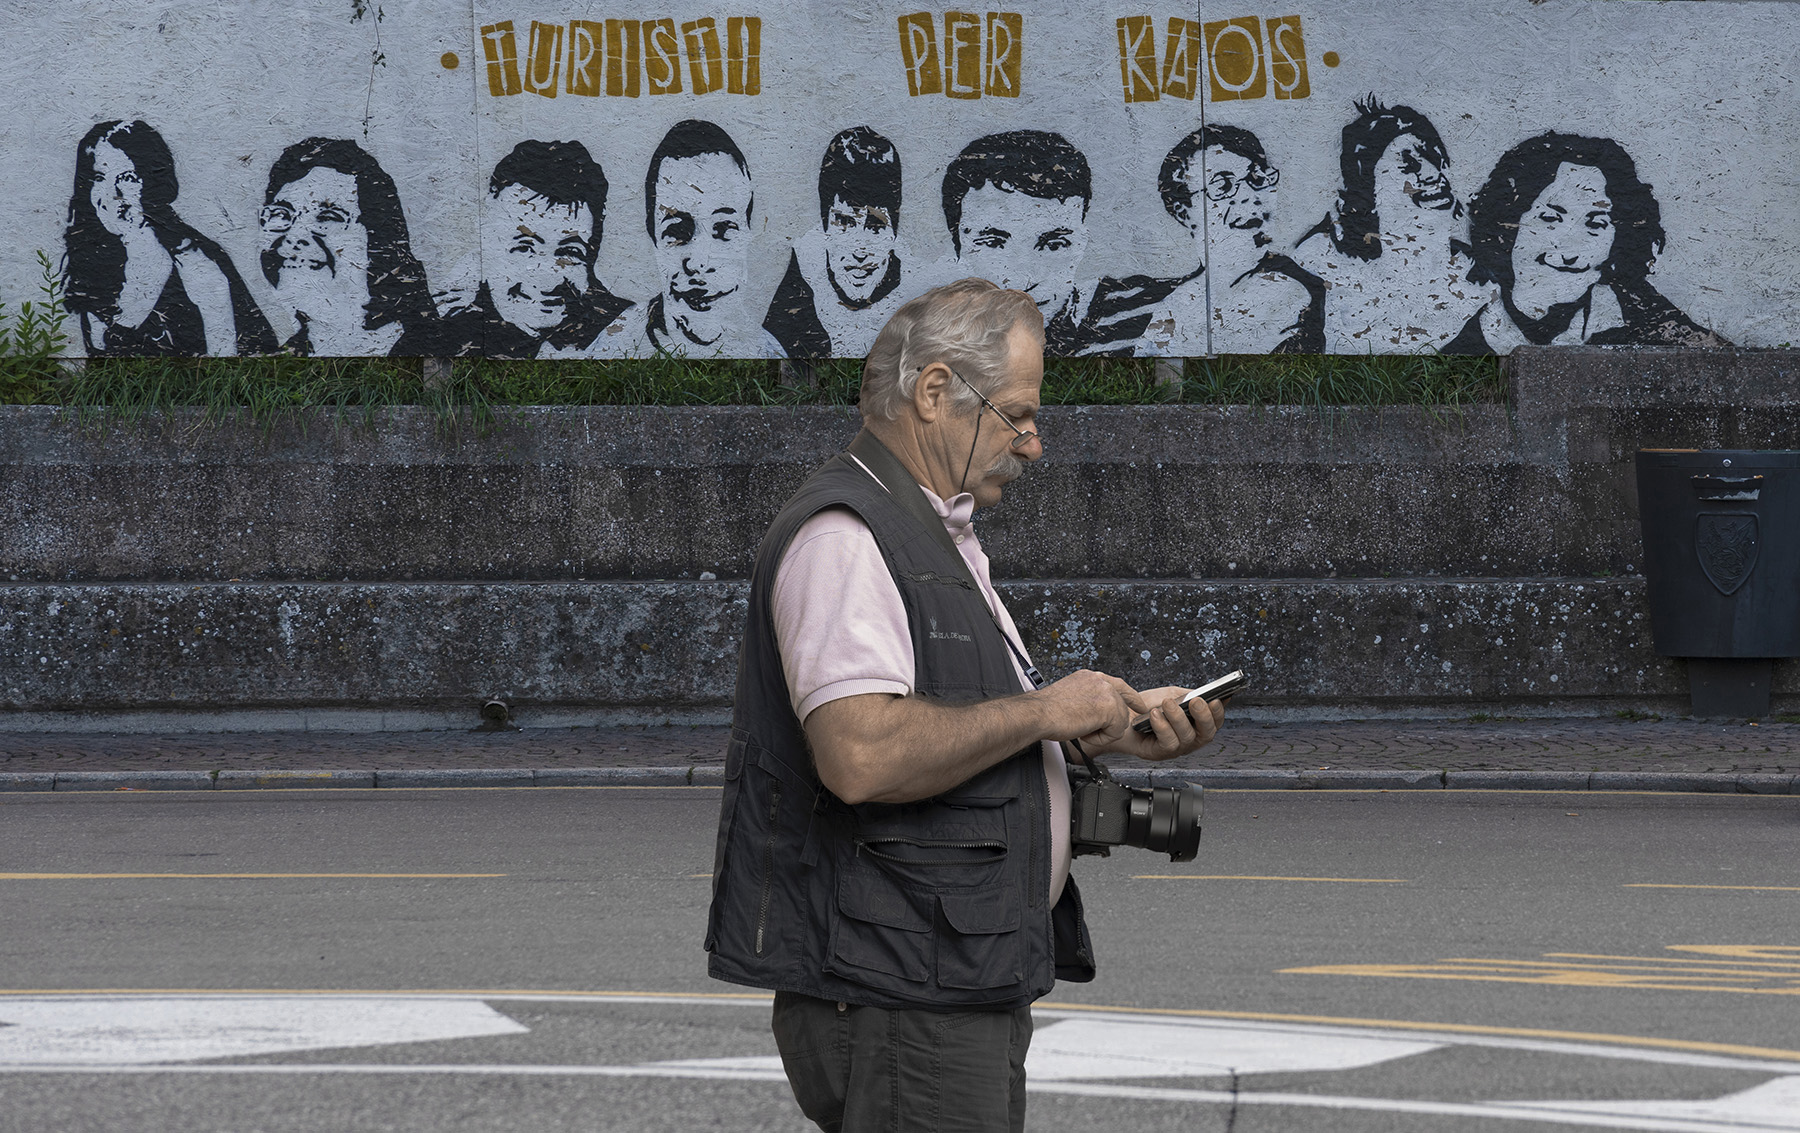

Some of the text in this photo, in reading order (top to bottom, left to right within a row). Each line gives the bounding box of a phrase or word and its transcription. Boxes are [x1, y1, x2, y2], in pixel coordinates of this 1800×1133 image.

[481, 12, 1310, 102] TURISTI PER KAOS
